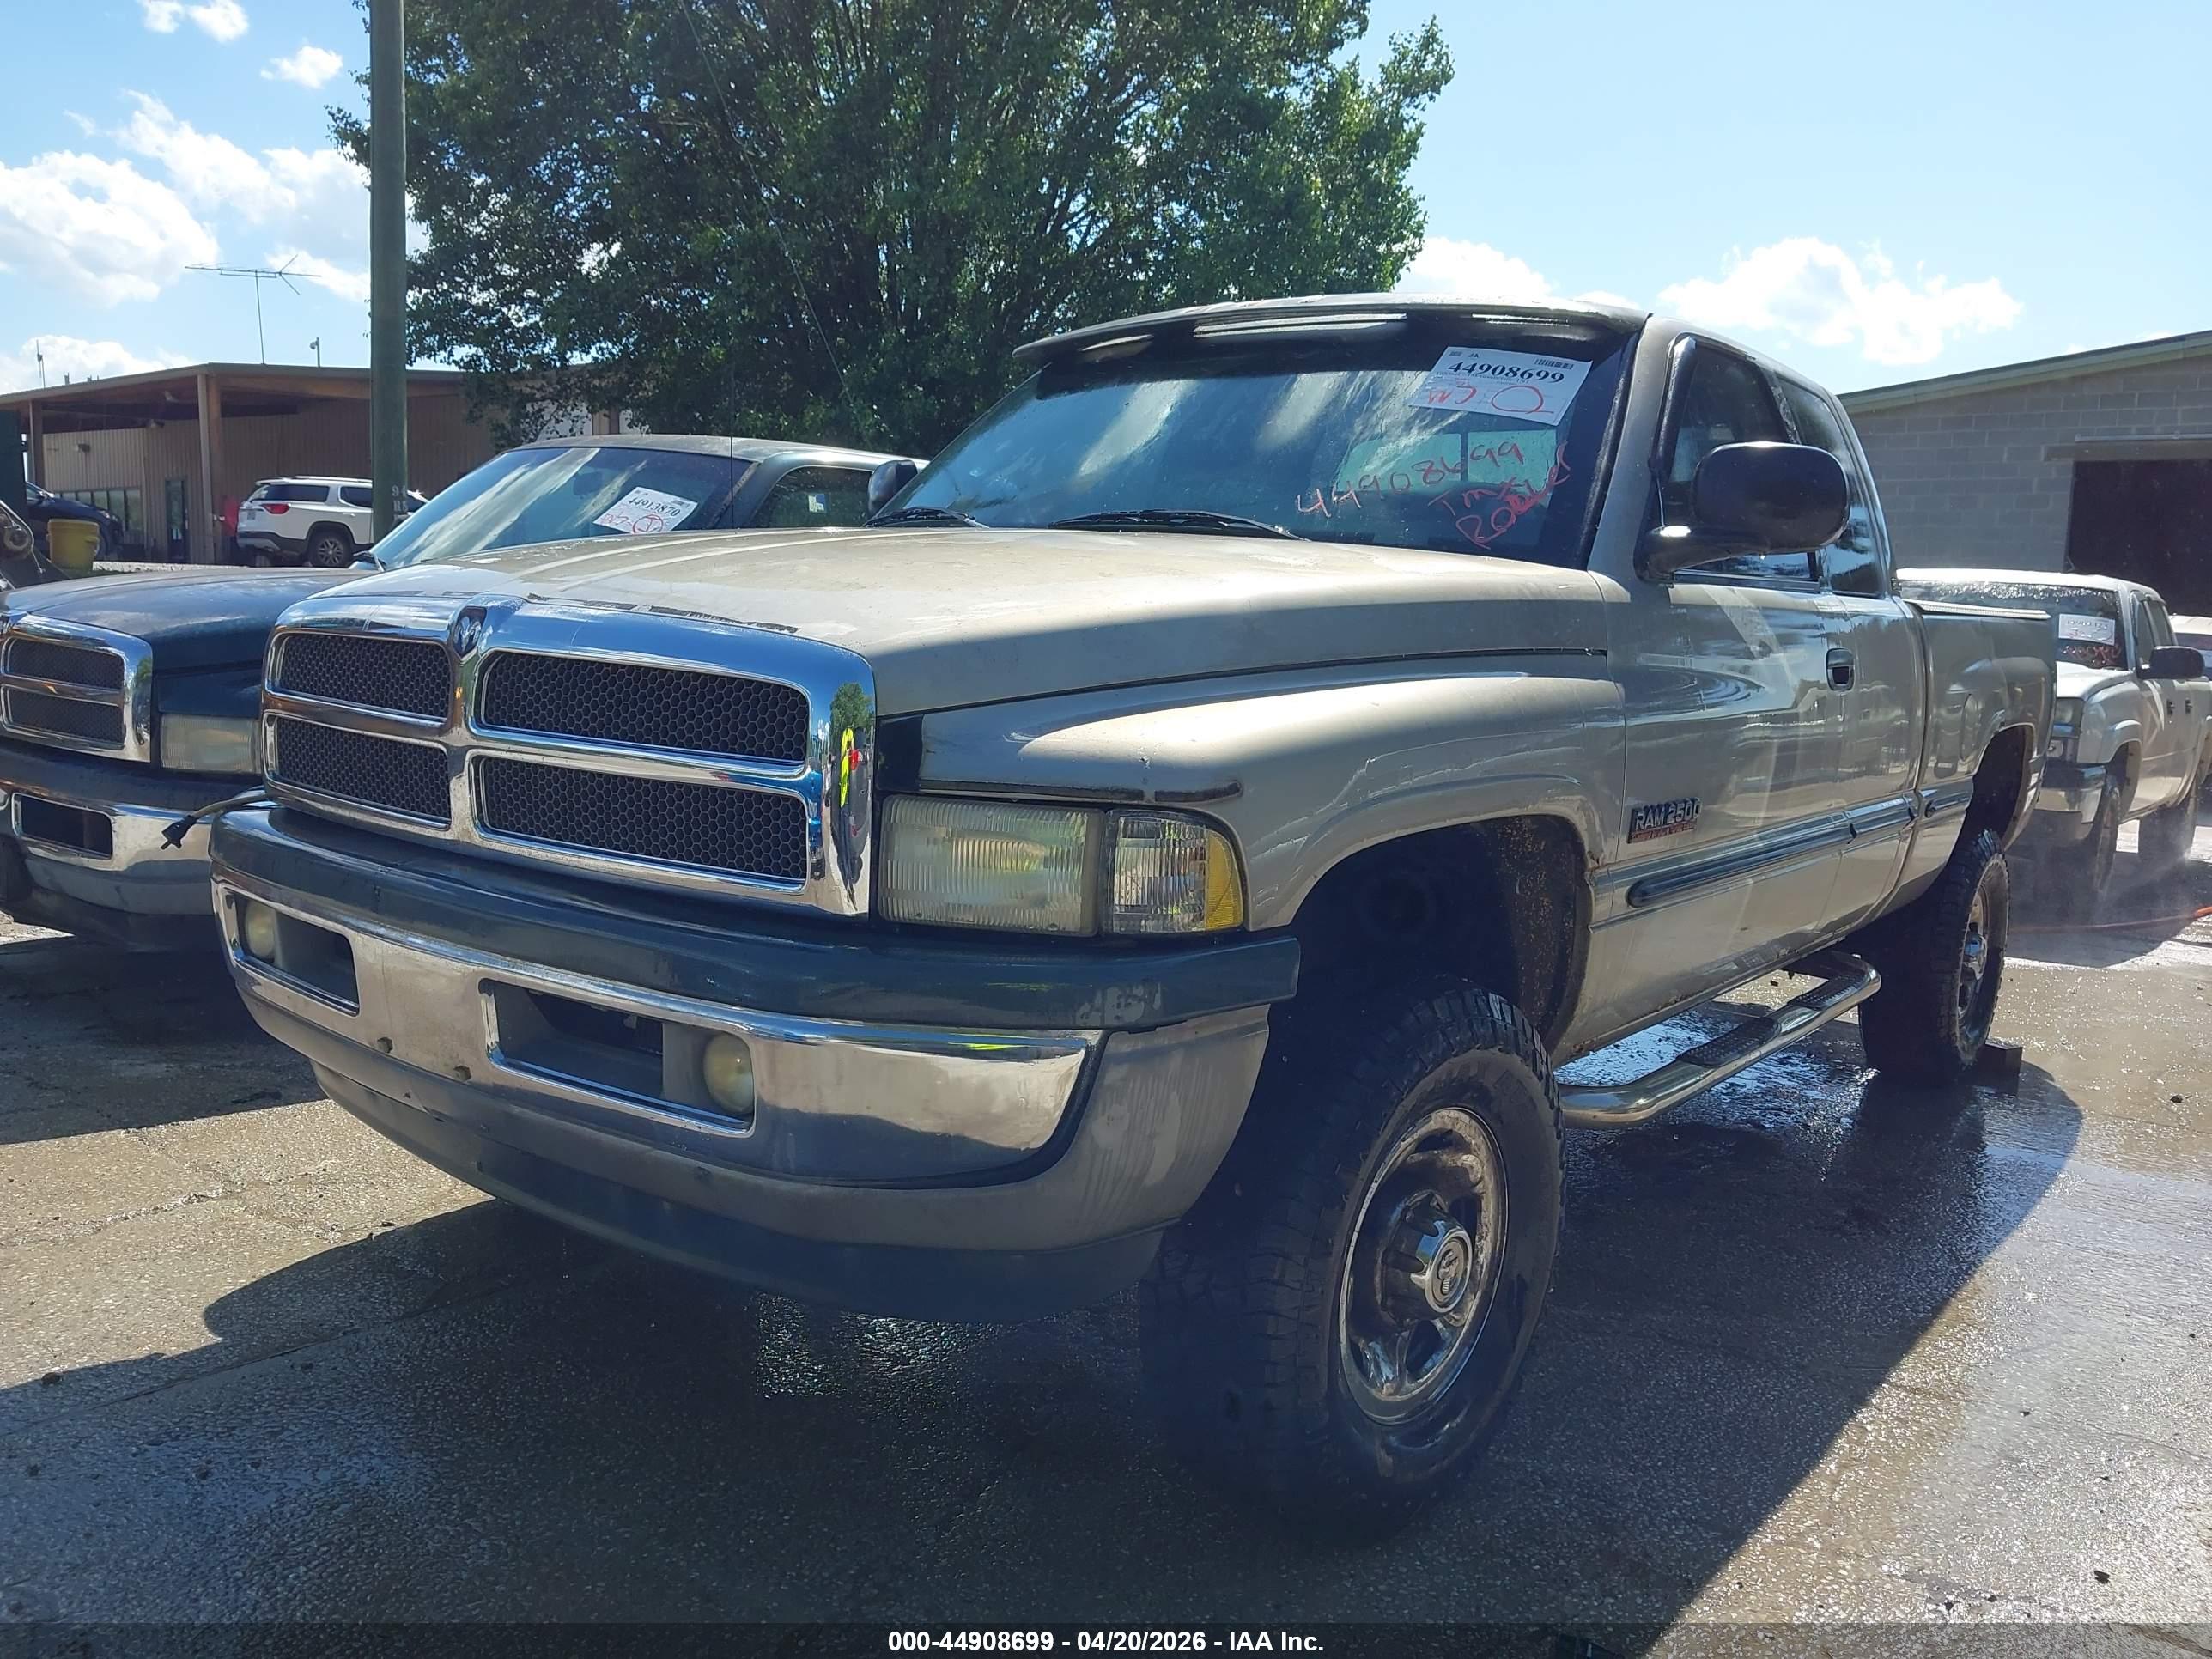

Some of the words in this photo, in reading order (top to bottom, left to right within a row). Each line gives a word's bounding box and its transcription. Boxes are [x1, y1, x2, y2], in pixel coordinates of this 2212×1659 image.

[1447, 361, 1565, 384] 44908699
[1635, 806, 1666, 831] RAM
[1667, 797, 1702, 824] 2500
